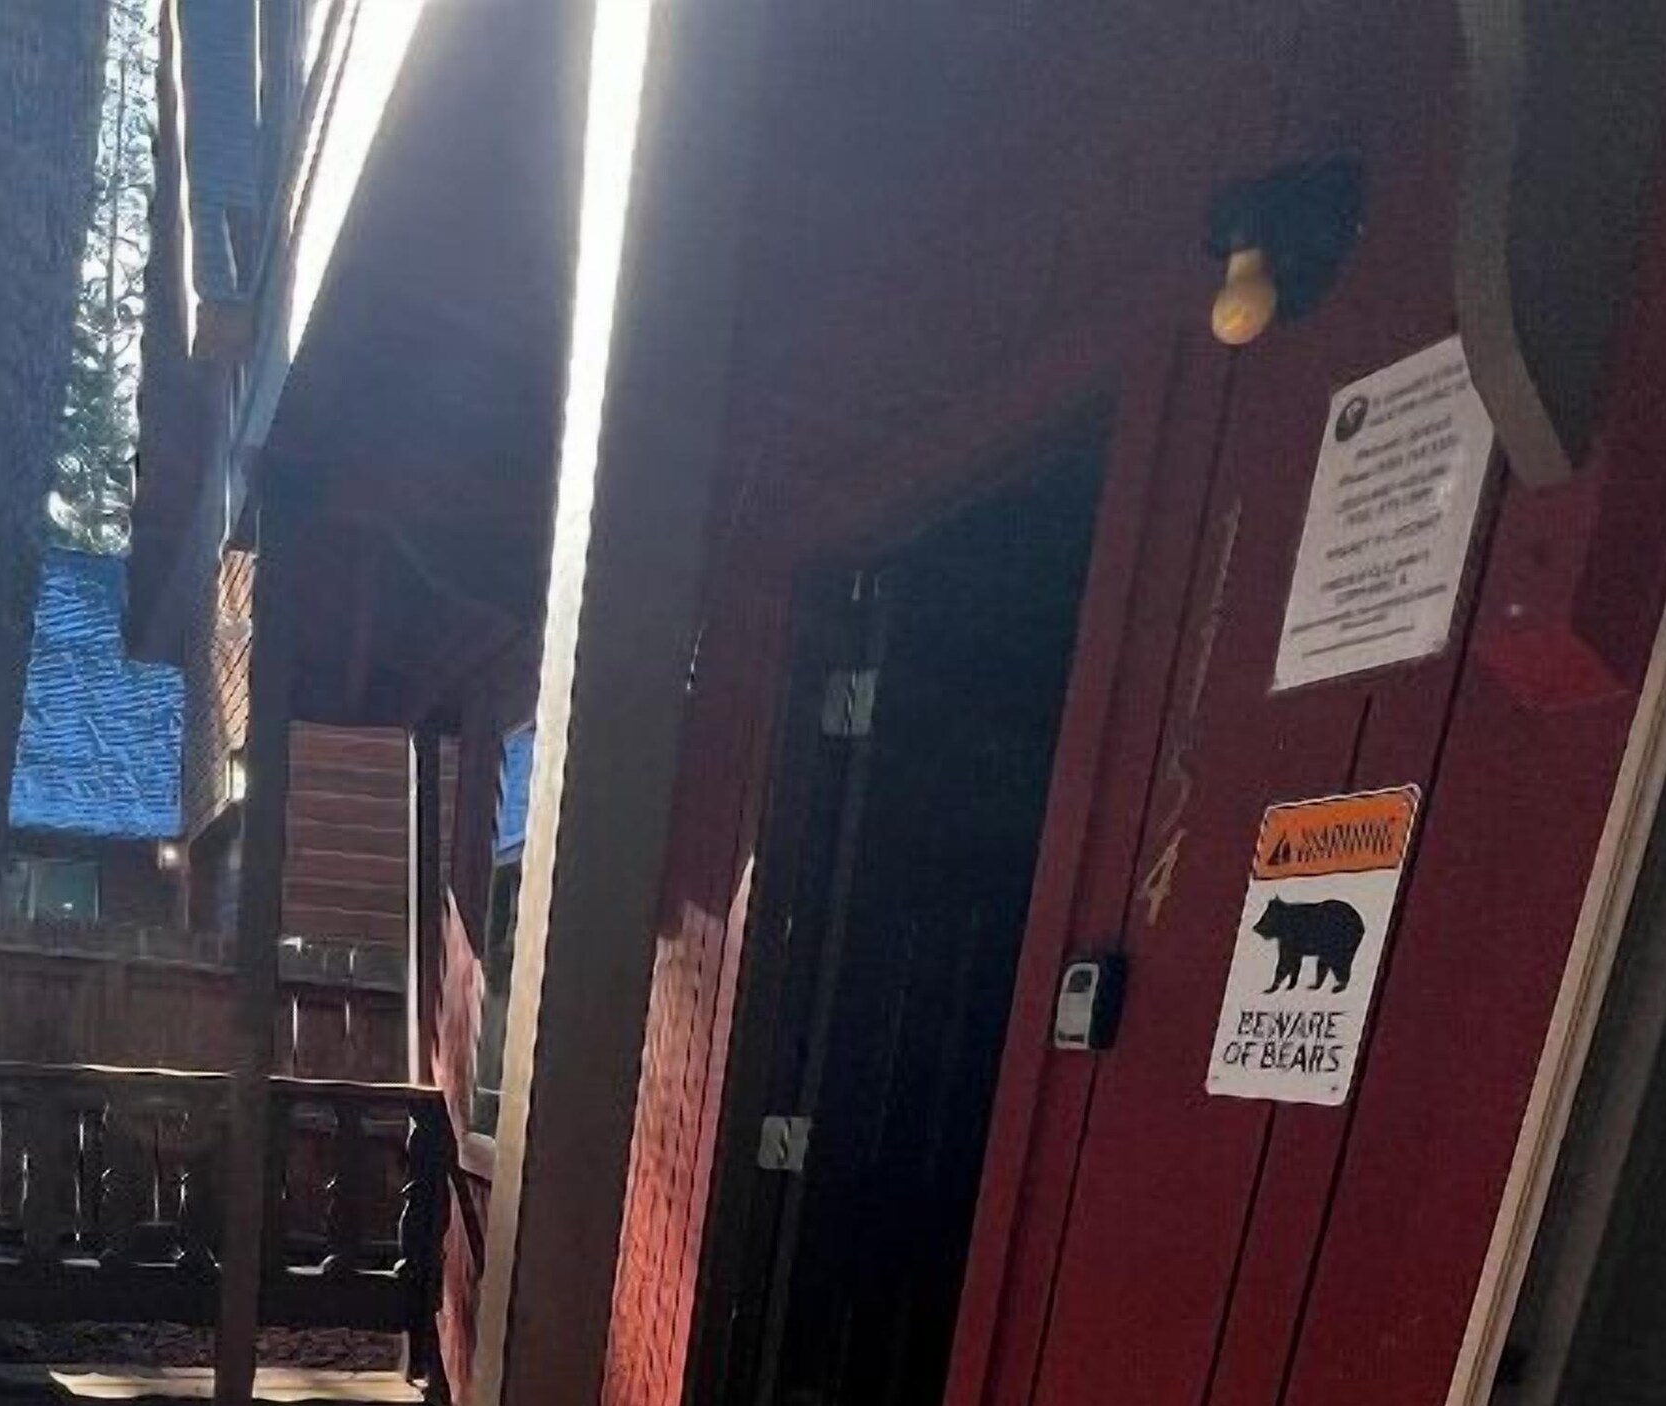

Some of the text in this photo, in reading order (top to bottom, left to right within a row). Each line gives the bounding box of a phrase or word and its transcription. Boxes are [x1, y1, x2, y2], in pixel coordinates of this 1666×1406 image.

[1237, 1011, 1344, 1039] BEWARE
[1223, 1041, 1344, 1074] OF BEARS
